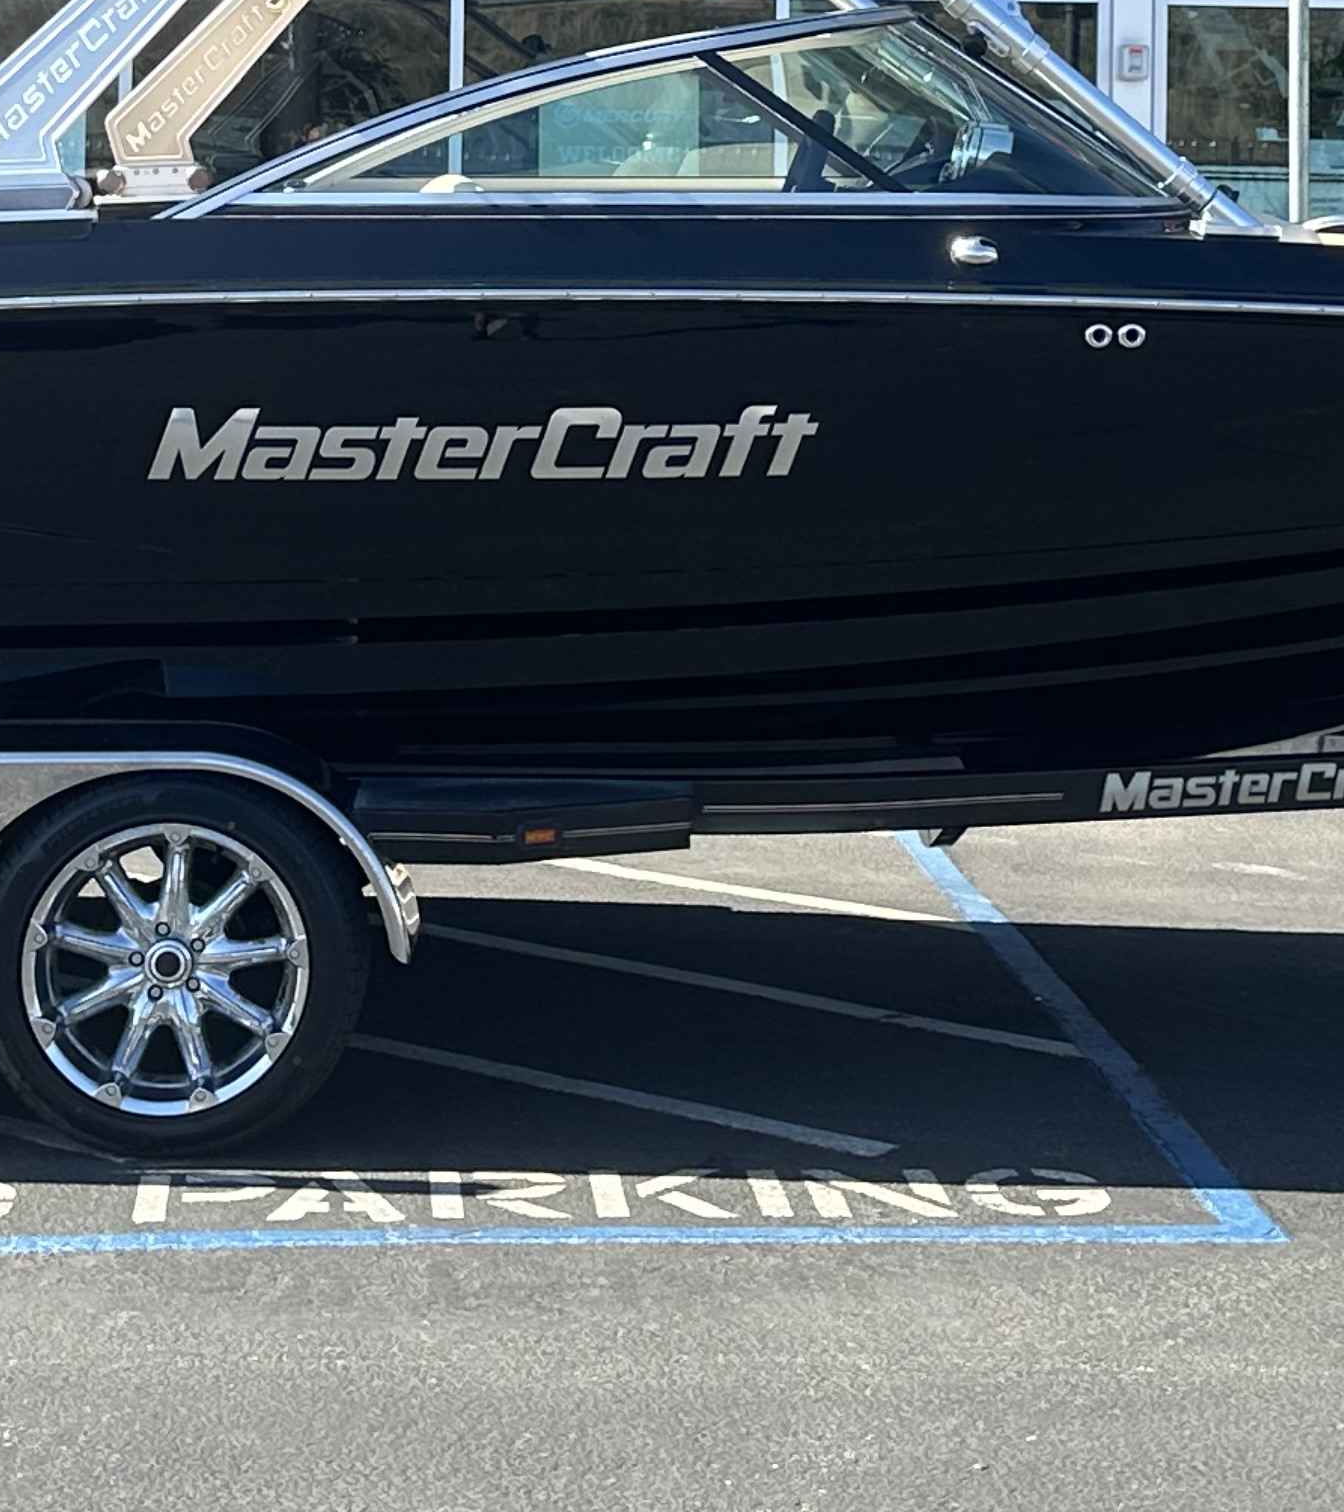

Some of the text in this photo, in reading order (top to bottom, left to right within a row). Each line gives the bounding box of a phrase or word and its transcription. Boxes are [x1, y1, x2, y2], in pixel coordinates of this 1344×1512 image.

[121, 4, 265, 153] MasterCraft
[146, 403, 819, 480] MasterCraft
[132, 1168, 1113, 1224] PARKING
